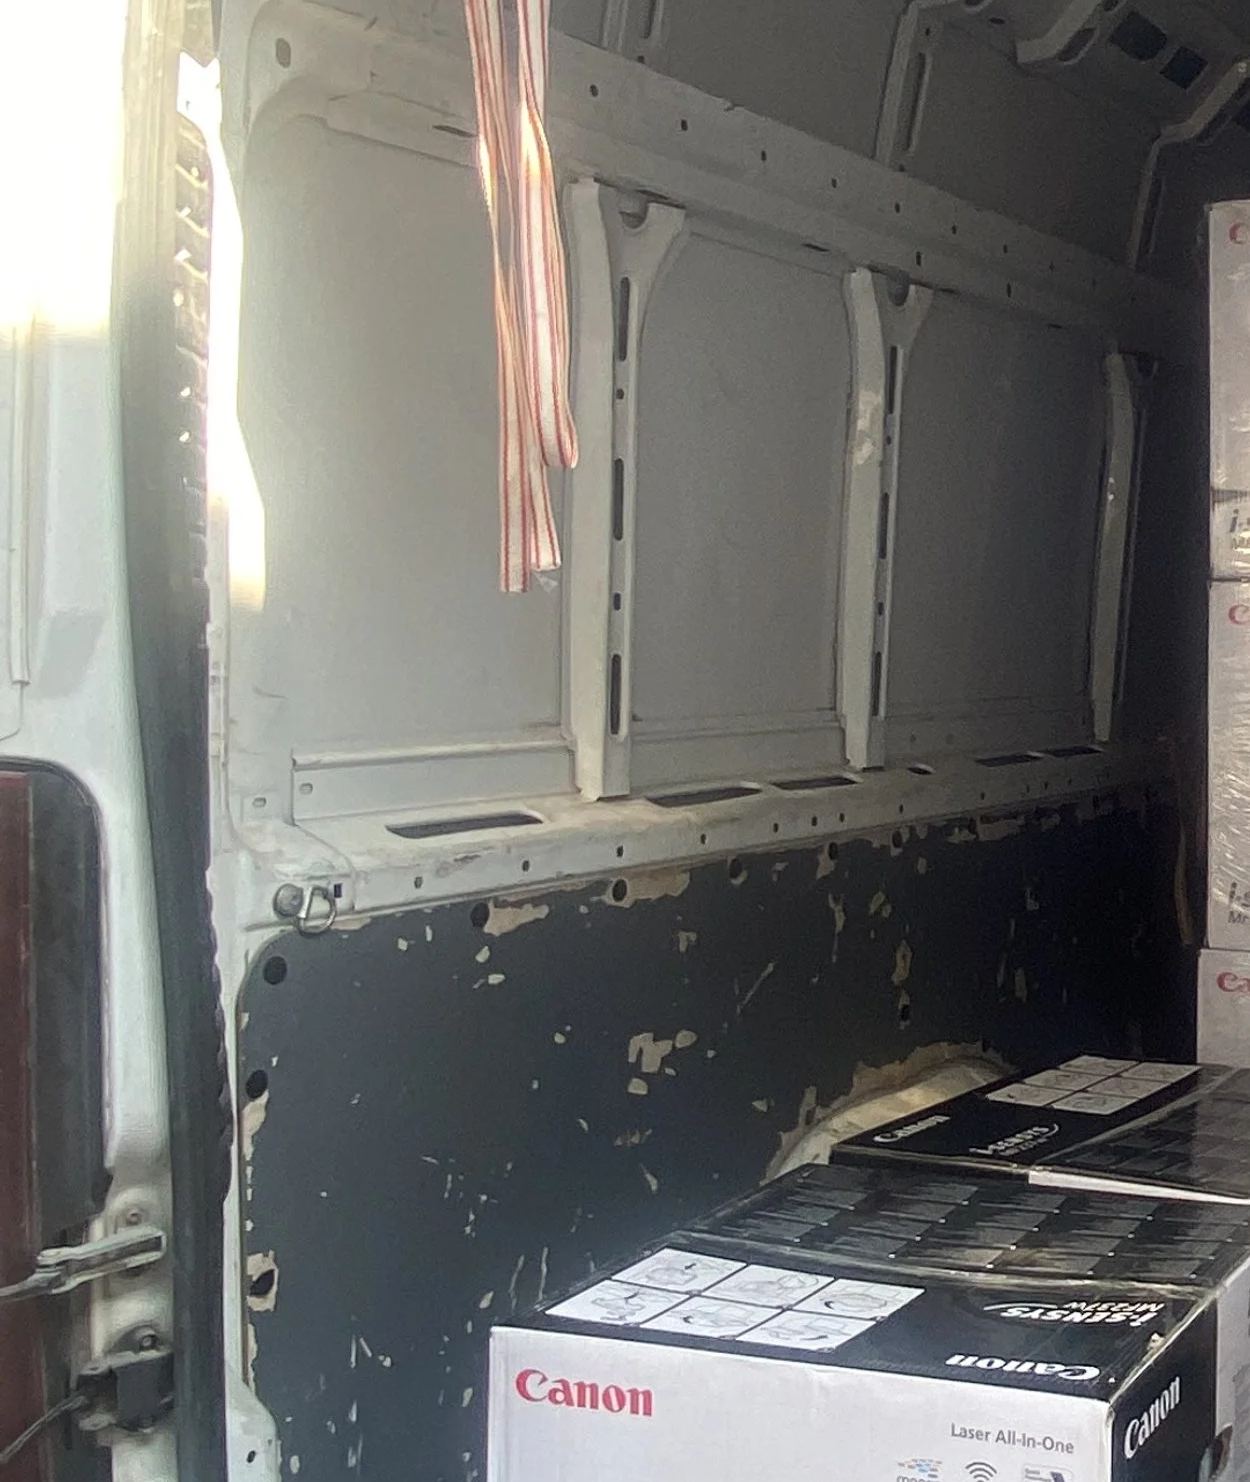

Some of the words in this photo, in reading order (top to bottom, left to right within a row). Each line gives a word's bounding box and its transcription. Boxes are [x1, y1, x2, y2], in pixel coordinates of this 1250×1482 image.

[1000, 1307, 1159, 1327] i-SENSYS
[945, 1354, 1100, 1381] Canon
[515, 1367, 653, 1418] Canon
[1124, 1376, 1181, 1459] Canon
[951, 1422, 991, 1442] Laser
[995, 1430, 1075, 1454] All-In-One
